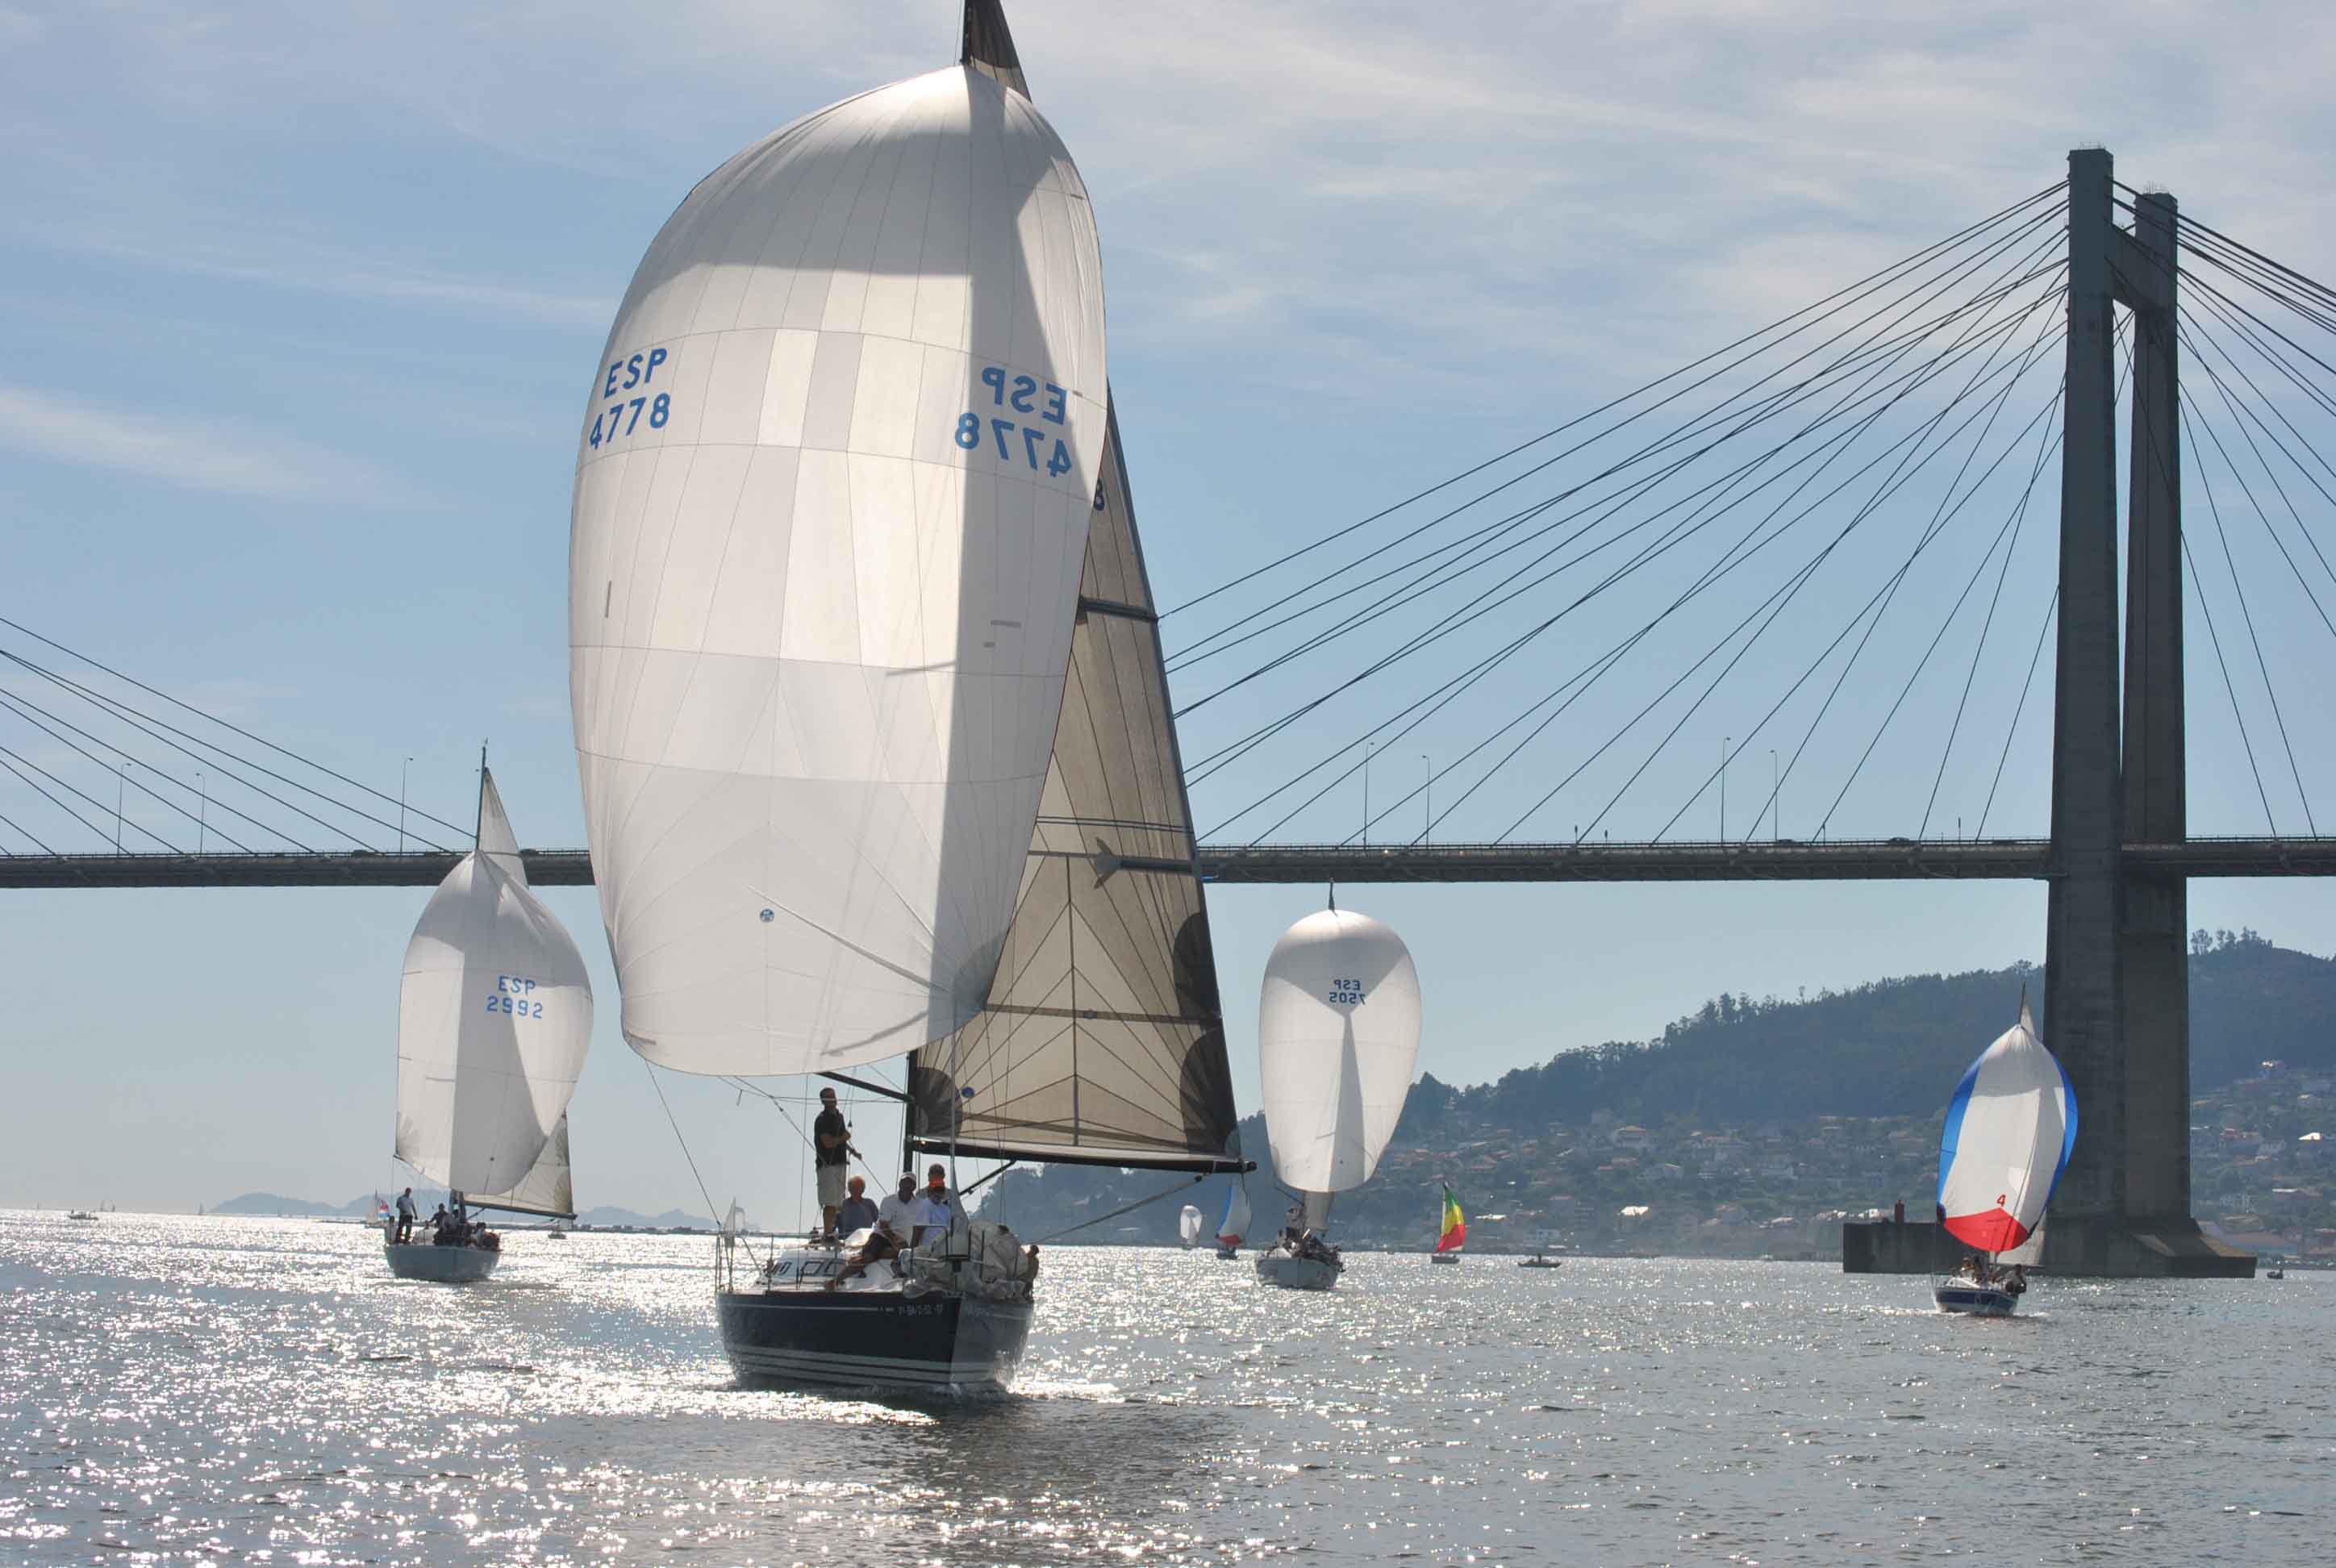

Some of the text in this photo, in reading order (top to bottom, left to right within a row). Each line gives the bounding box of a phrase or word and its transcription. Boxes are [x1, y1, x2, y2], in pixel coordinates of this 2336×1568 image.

[604, 348, 668, 399] ESP
[590, 392, 671, 450] 4778
[498, 974, 536, 995] ESP
[486, 995, 543, 1020] 2992
